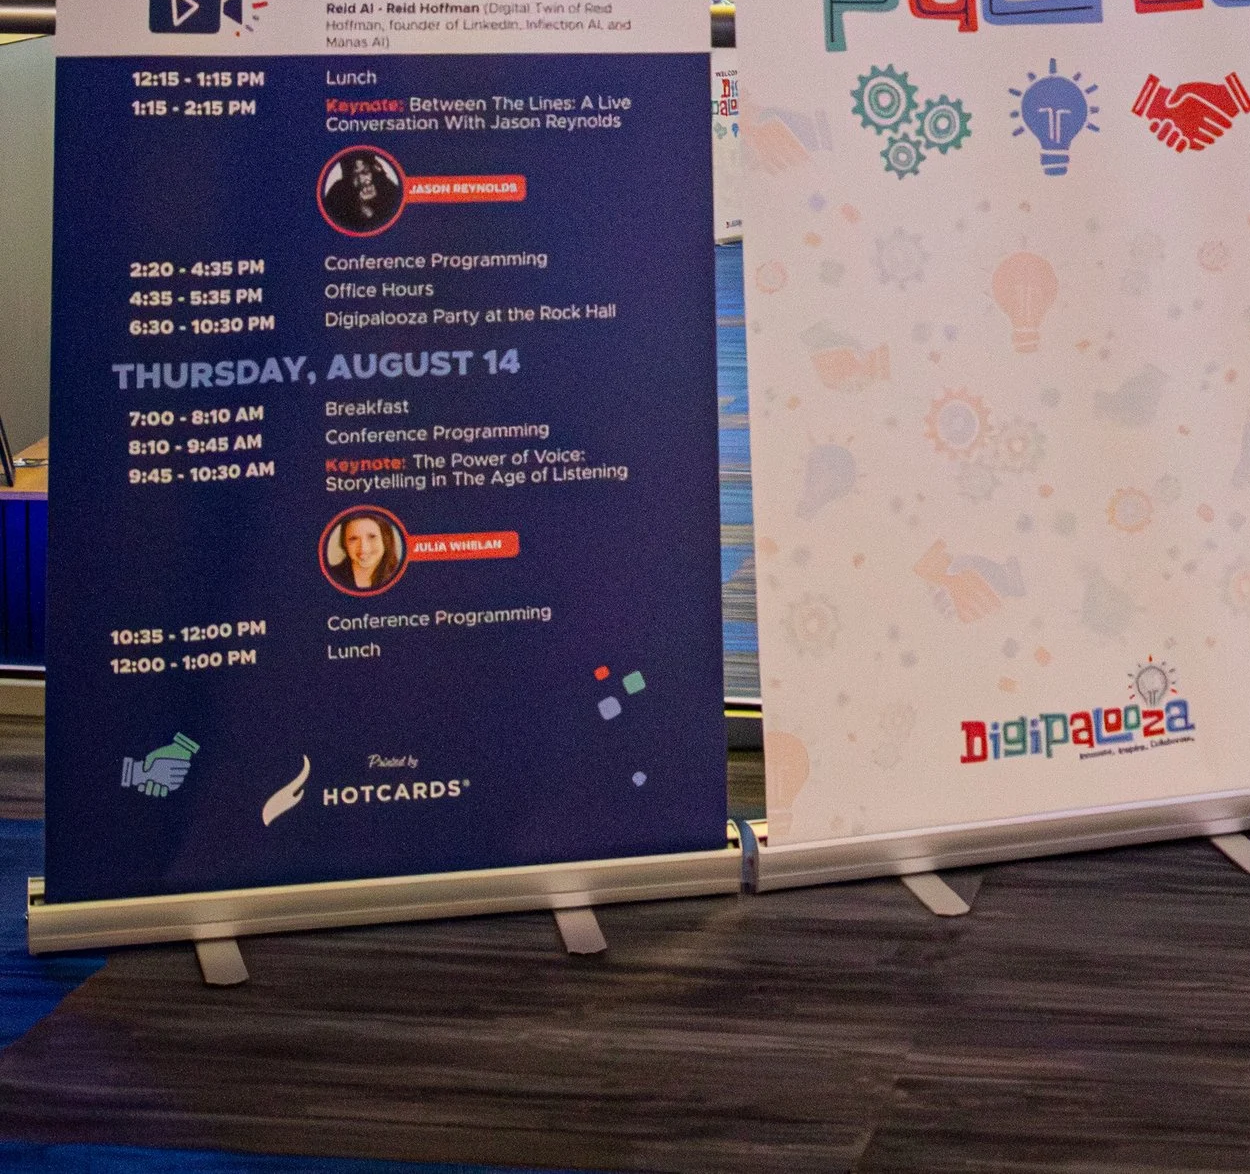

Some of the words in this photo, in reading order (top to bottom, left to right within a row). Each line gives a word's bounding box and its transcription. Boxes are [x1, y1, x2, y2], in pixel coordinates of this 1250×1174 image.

[326, 2, 356, 15] Reid
[360, 2, 375, 14] AI
[386, 2, 416, 15] Reid
[420, 2, 480, 14] Hoffman
[446, 19, 459, 30] of
[325, 69, 378, 86] Lunch
[409, 96, 487, 113] Between
[491, 95, 525, 111] The
[528, 96, 576, 111] Lines:
[580, 95, 594, 110] A
[598, 95, 632, 111] Live
[325, 116, 439, 133] Conversation
[444, 115, 486, 131] With
[490, 114, 541, 130] Jason
[545, 113, 622, 132] Reynolds
[409, 183, 450, 195] JASON
[453, 182, 518, 195] REYNOLDS
[323, 254, 427, 272] Conference
[430, 251, 549, 272] Programming
[323, 282, 378, 300] Office
[381, 282, 435, 297] Hours
[128, 318, 175, 337] 6:30
[190, 316, 245, 335] 10:30
[246, 314, 276, 332] PM
[324, 310, 428, 331] Digipalooza
[432, 308, 480, 327] Party
[484, 308, 503, 323] at
[507, 306, 536, 323] the
[539, 303, 582, 321] Rock
[584, 303, 617, 320] Hall
[111, 355, 317, 390] THURSDAY,
[326, 349, 474, 380] AUGUST
[482, 348, 521, 375] 14
[324, 398, 410, 417] Breakfast
[324, 427, 429, 446] Conference
[432, 422, 550, 443] Programming
[412, 453, 446, 469] The
[450, 452, 506, 468] Power
[511, 449, 529, 466] of
[533, 449, 586, 464] Voice:
[127, 467, 174, 485] 9:45
[189, 463, 242, 483] 10:30
[244, 460, 276, 479] AM
[325, 473, 427, 493] Storytelling
[431, 472, 448, 487] in
[452, 470, 486, 487] The
[490, 469, 527, 488] Age
[530, 466, 549, 484] of
[552, 463, 629, 482] Listening
[413, 541, 447, 554] JULIA
[450, 539, 502, 553] WHELAN
[326, 613, 431, 632] Conference
[434, 605, 553, 628] Programming
[109, 656, 167, 675] 12:00
[181, 651, 224, 671] 1:00
[226, 648, 258, 667] PM
[326, 642, 382, 661] Lunch
